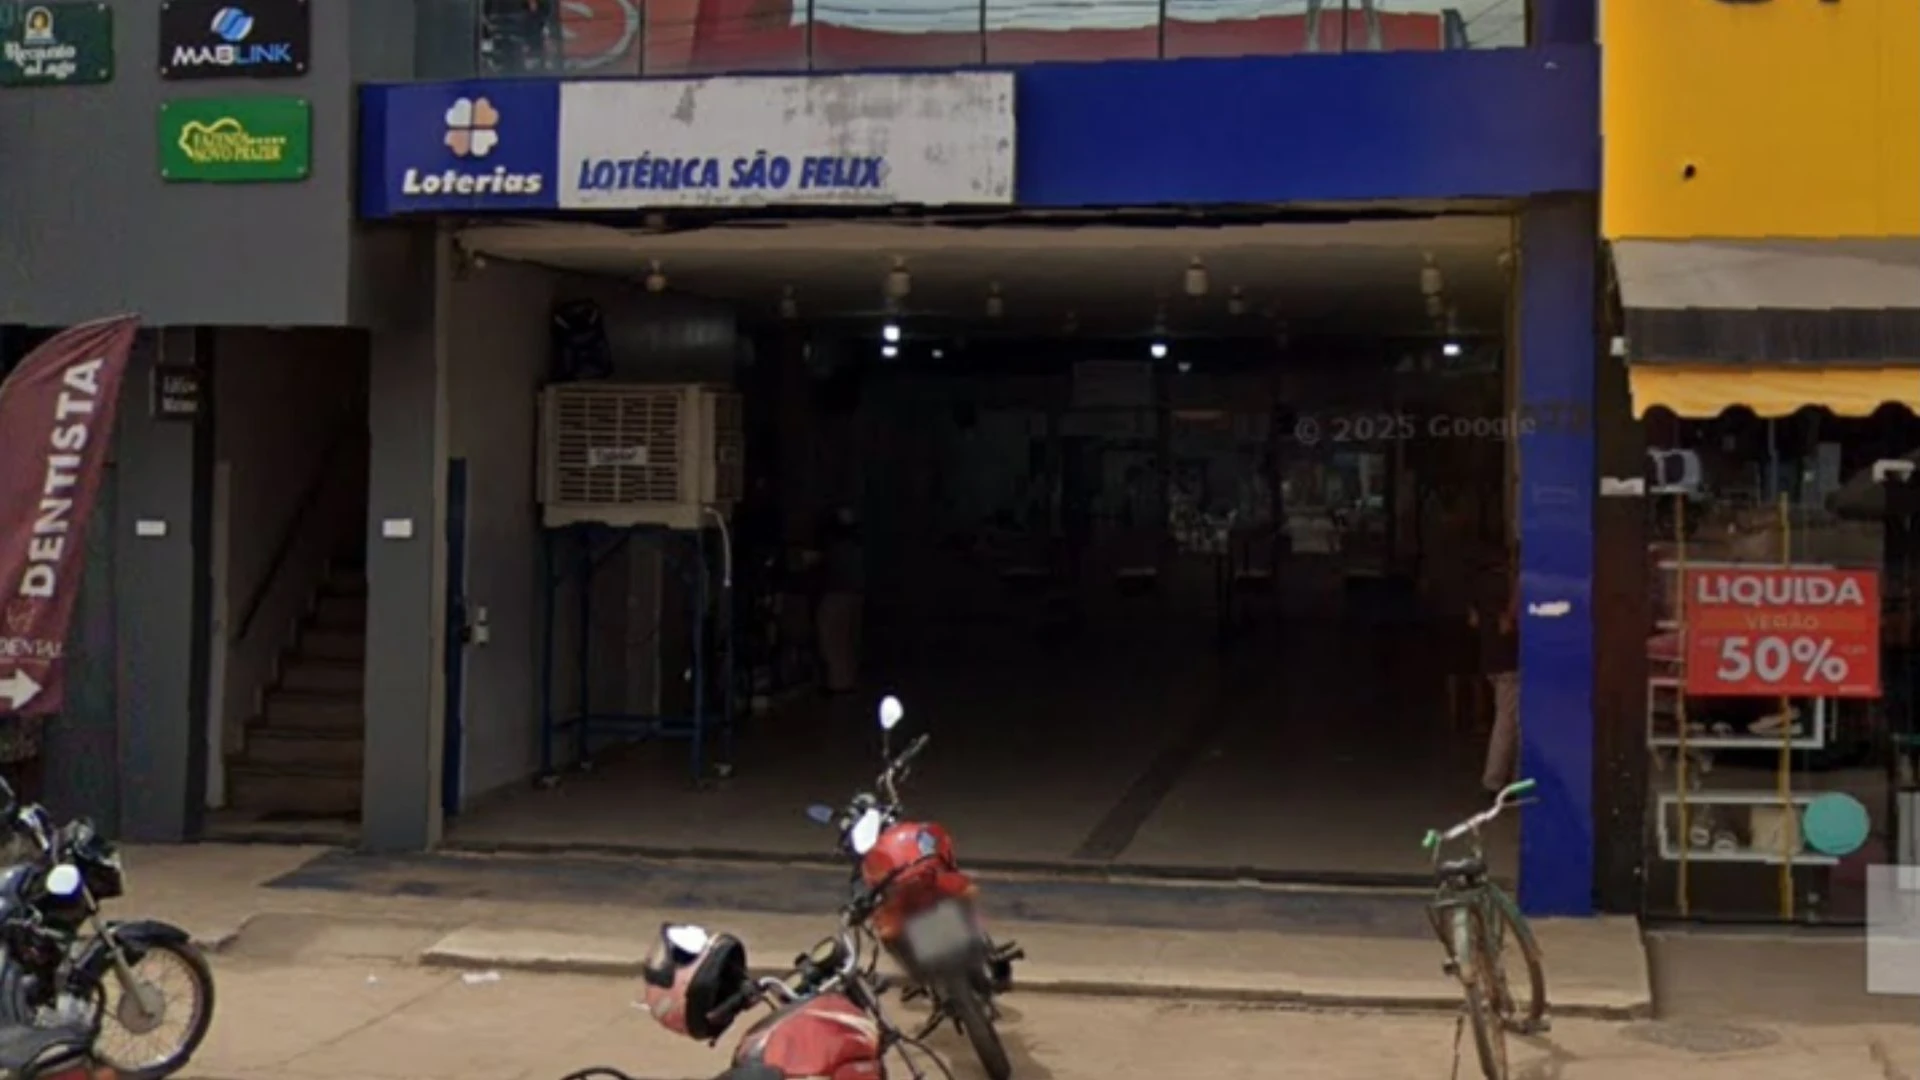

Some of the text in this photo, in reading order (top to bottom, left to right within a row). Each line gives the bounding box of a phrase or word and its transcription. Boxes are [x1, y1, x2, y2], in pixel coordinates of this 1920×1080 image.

[171, 43, 293, 67] MABLINK
[402, 165, 542, 195] Loterias
[577, 150, 884, 190] LOTÉRICA SÃO FELIX
[20, 356, 103, 599] DENTISTA
[1697, 575, 1865, 607] LIQUIDA
[1745, 609, 1820, 631] VERÃO
[1717, 635, 1849, 683] 50%
